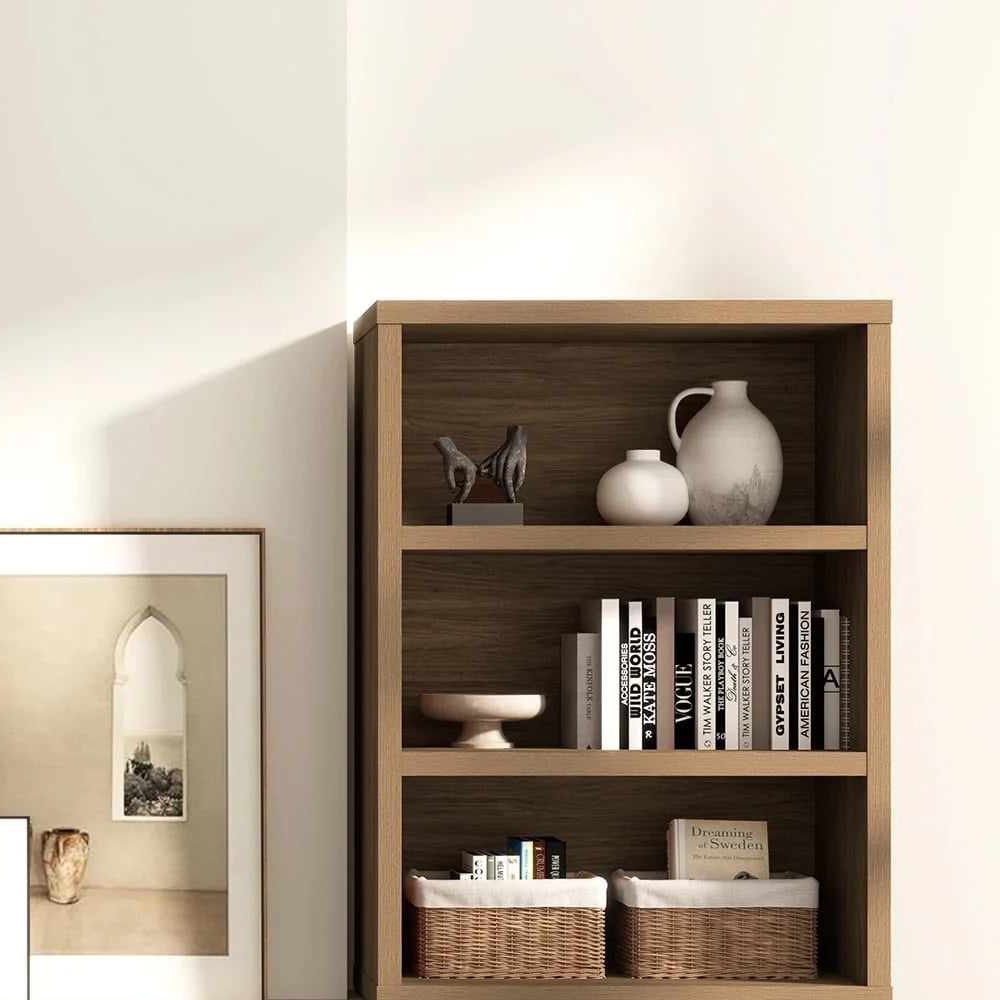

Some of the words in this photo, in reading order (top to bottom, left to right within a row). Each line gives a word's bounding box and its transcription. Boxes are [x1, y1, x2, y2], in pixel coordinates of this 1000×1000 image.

[702, 603, 712, 637] TELLER
[629, 627, 642, 679] WORLD
[642, 633, 656, 678] MOSS
[702, 638, 712, 671] STORY
[717, 637, 725, 659] BOOK
[742, 627, 750, 657] TELLER
[775, 612, 785, 664] LIVING
[800, 610, 810, 667] FASHION
[620, 643, 629, 706] ACCESSORIES
[717, 660, 725, 695] PLAYBOY
[742, 658, 750, 685] STORY
[629, 684, 642, 719] WILD
[642, 682, 656, 725] KATE
[674, 663, 693, 724] VOGUE
[702, 672, 712, 715] WALKER
[717, 696, 725, 711] THE
[742, 686, 750, 722] WALKER
[775, 675, 785, 736] GYPSET
[800, 670, 810, 738] AMERICAN
[702, 717, 712, 735] TIM
[742, 723, 750, 738] TIM
[691, 826, 753, 840] Dreaming
[710, 838, 764, 850] Sweden
